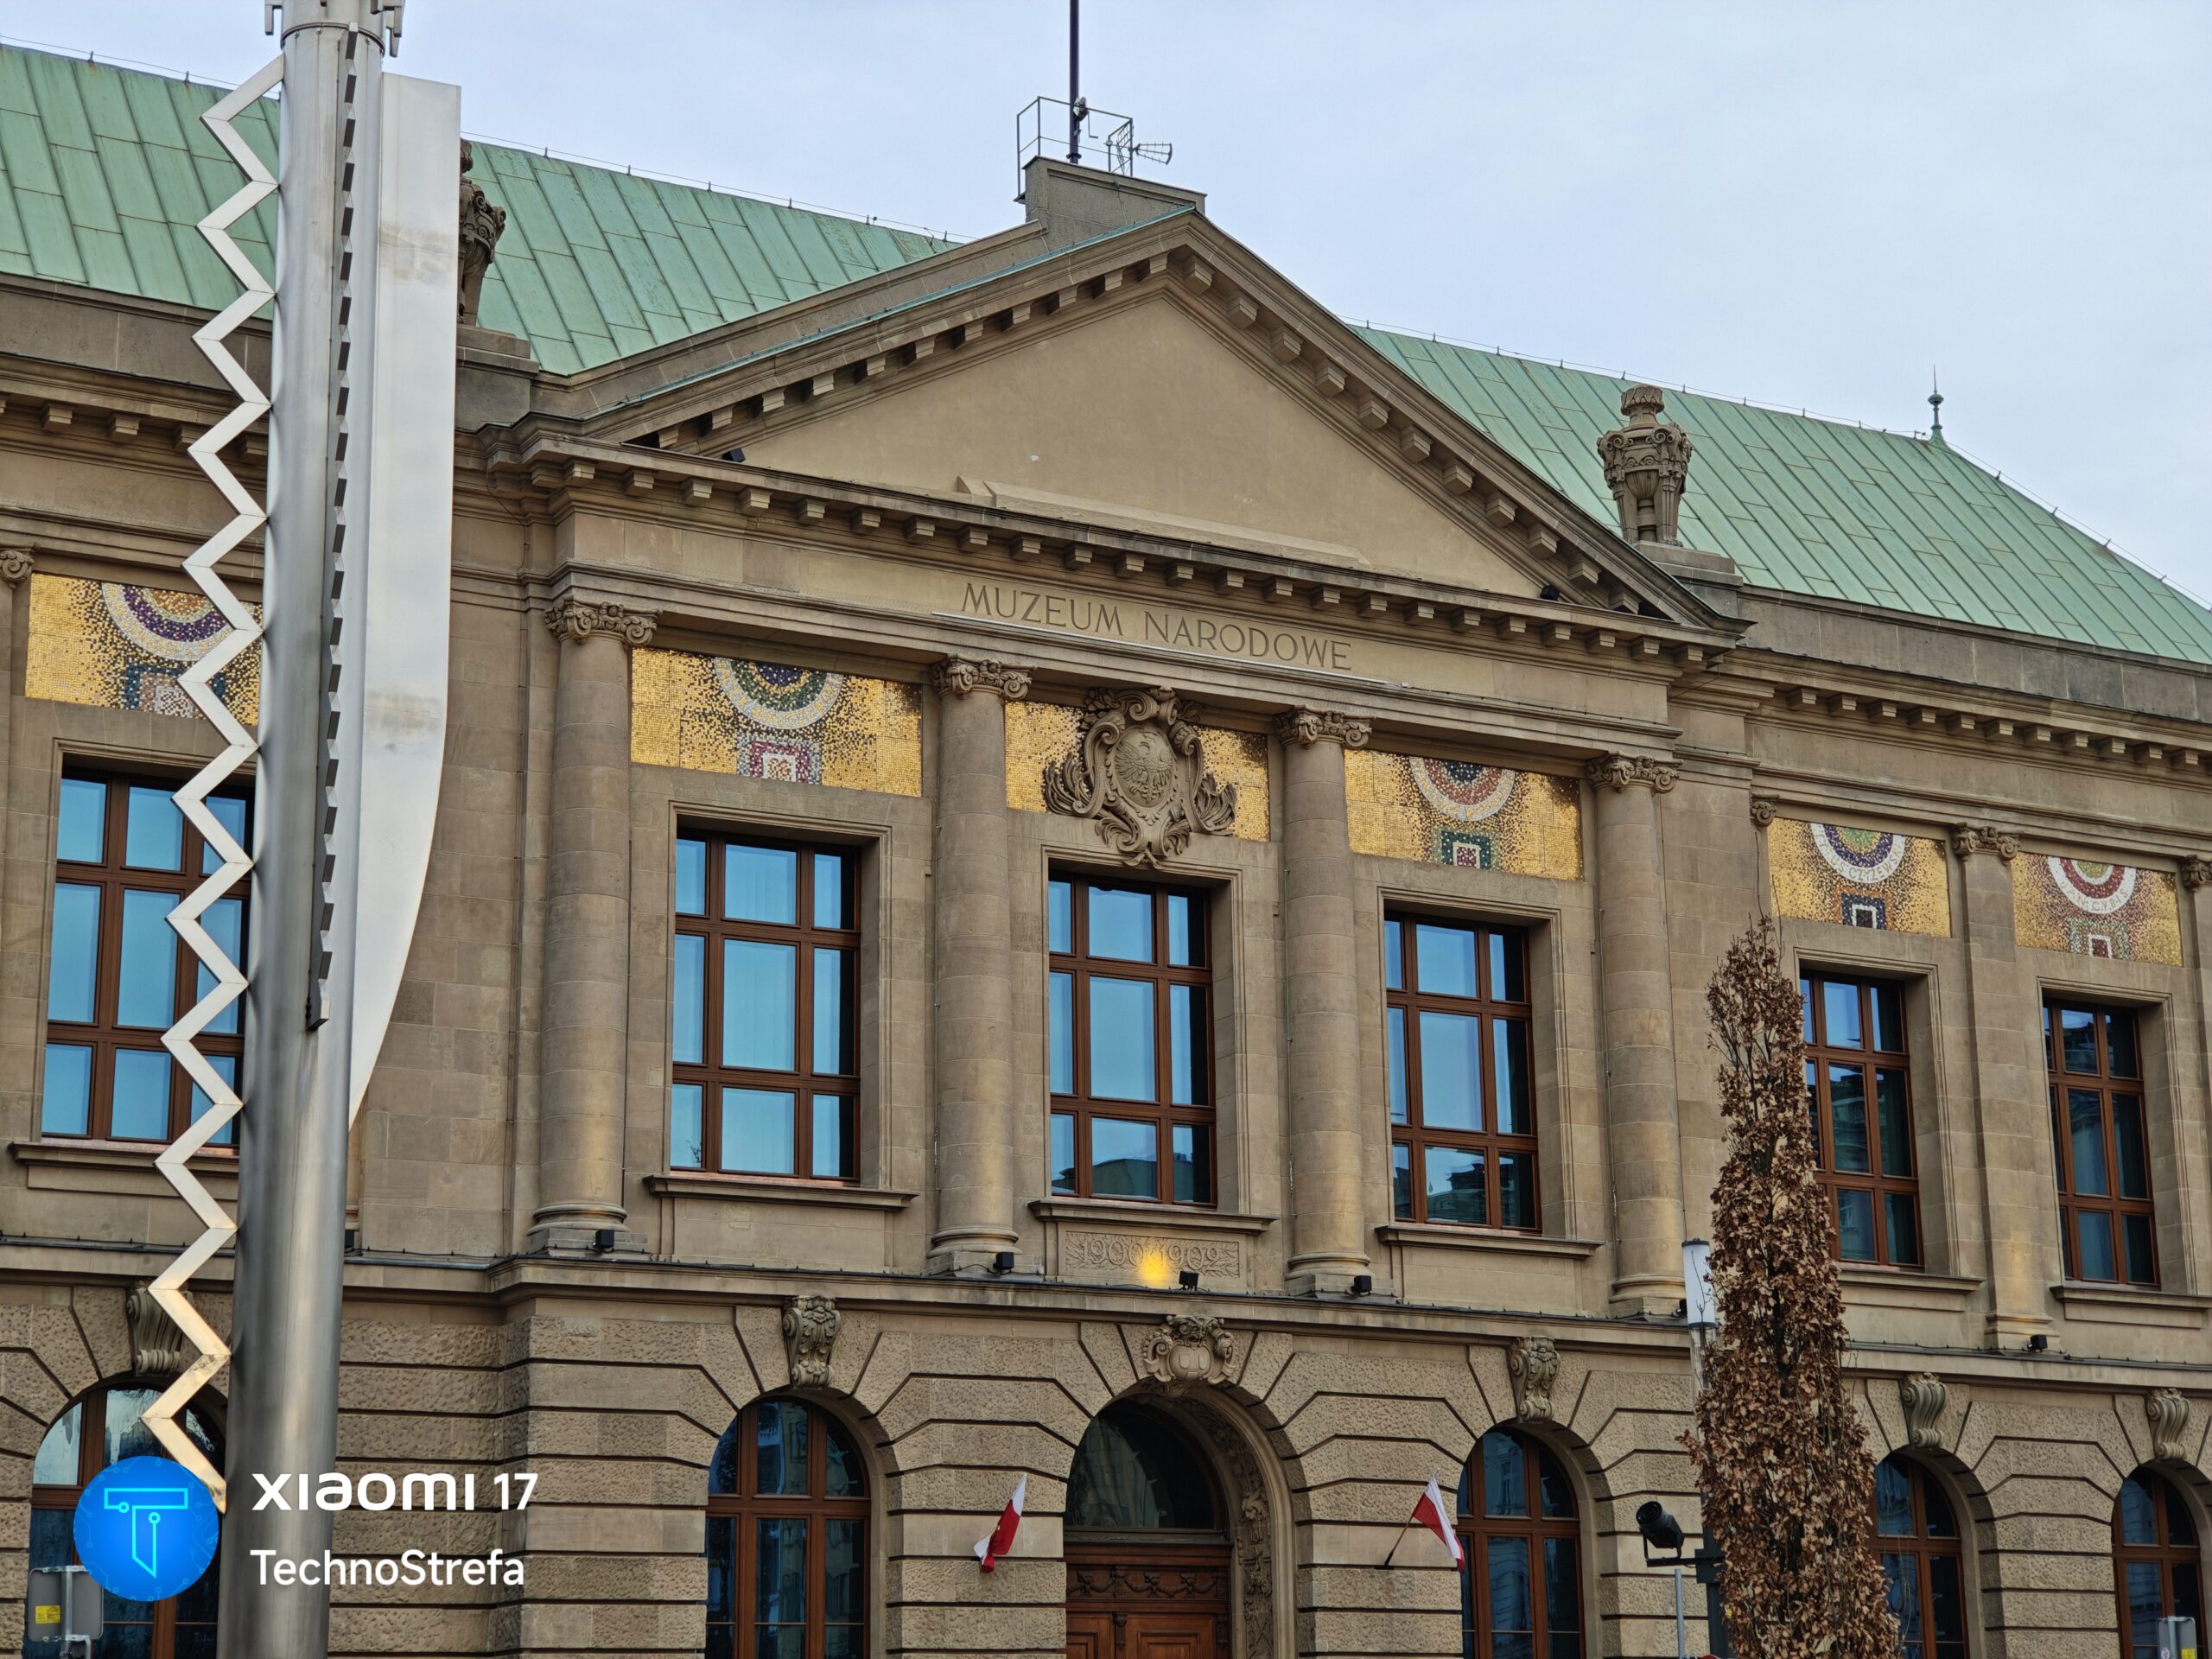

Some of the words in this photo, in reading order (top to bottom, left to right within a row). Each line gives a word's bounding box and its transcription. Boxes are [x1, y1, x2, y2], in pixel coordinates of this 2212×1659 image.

[961, 582, 1123, 636] MUZEUM
[1145, 611, 1351, 671] NARODOWE
[2092, 888, 2128, 912] CYBIS
[1082, 1239, 1144, 1266] 1900
[1159, 1242, 1221, 1271] 1902
